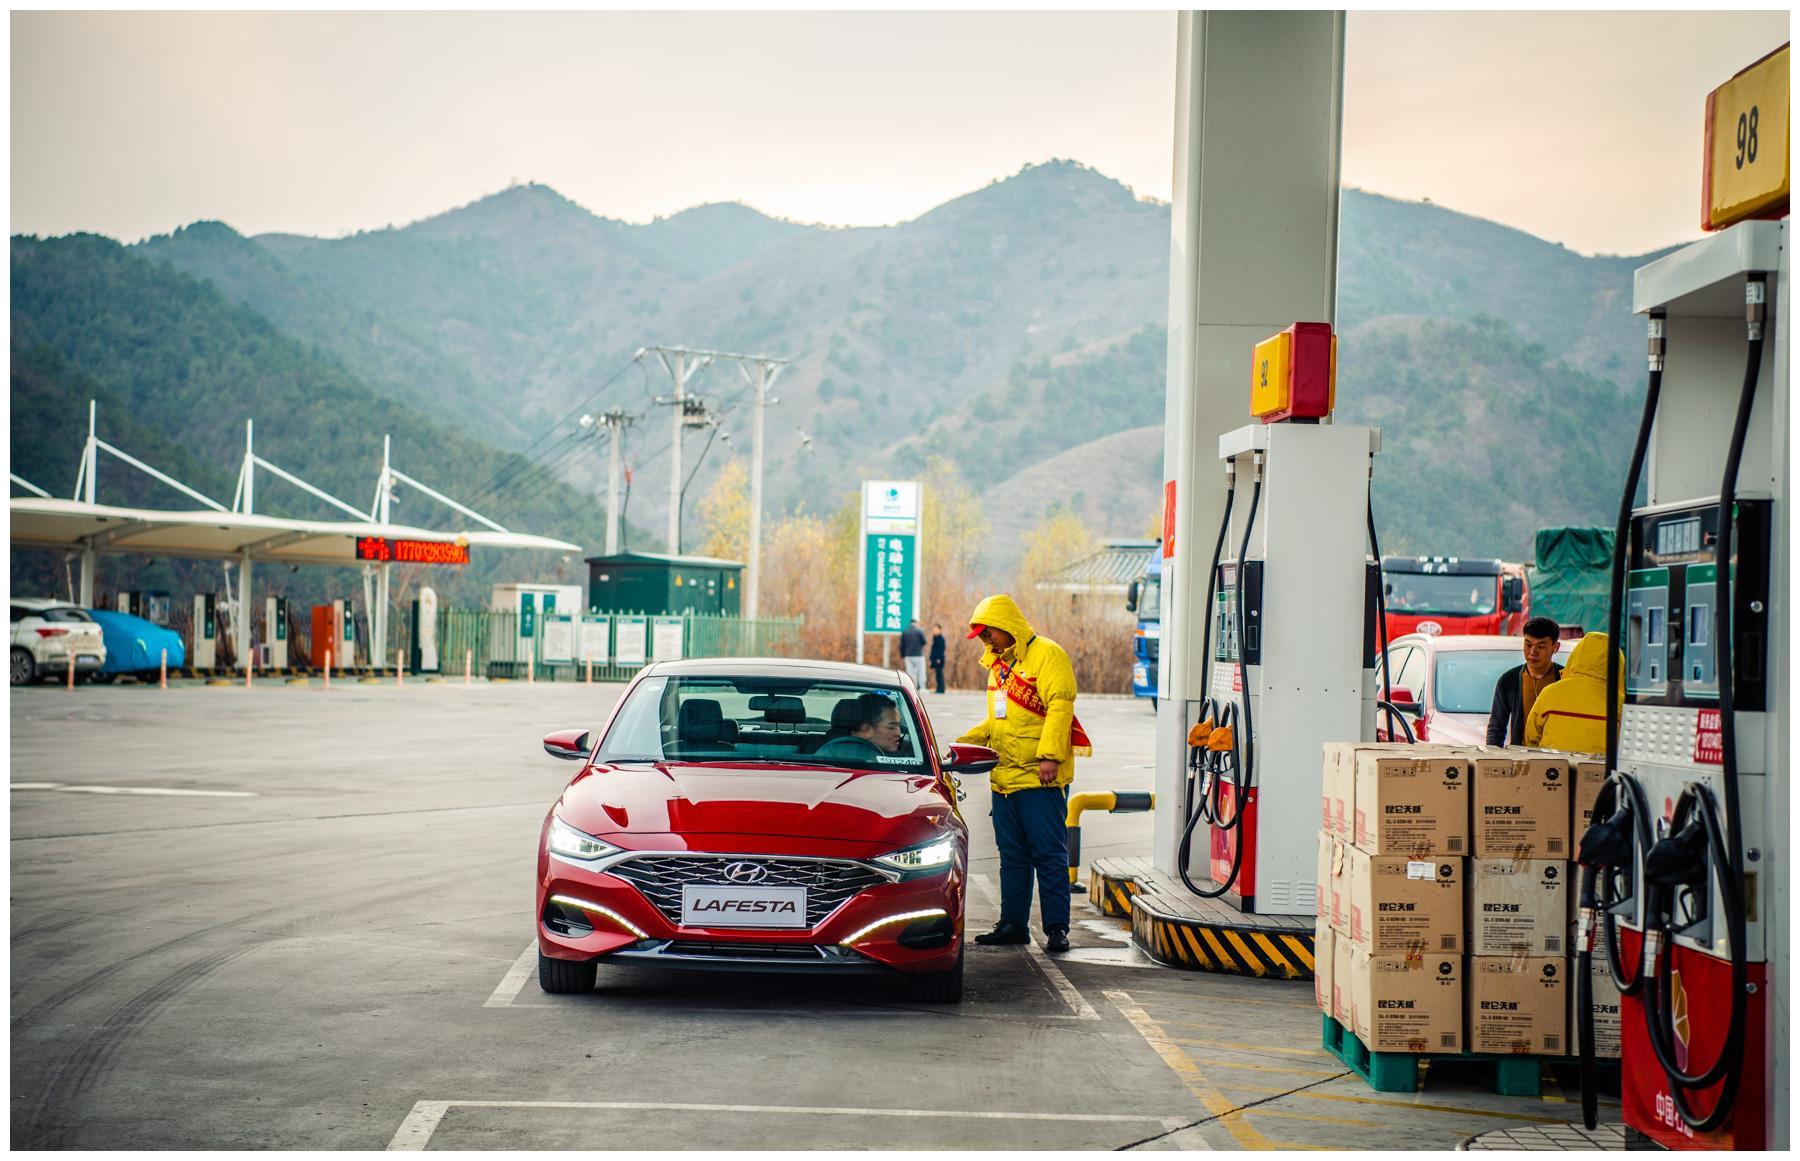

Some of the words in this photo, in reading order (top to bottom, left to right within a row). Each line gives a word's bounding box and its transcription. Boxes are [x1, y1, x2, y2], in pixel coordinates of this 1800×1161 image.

[1736, 105, 1759, 170] 98
[1261, 359, 1269, 389] 92
[887, 537, 904, 630] 电动汽车充电站
[1385, 805, 1421, 814] 昆仑天威
[1484, 806, 1521, 815] 昆仑天威
[692, 898, 796, 913] LAFESTA
[1378, 903, 1415, 912] 昆仑天威
[1483, 903, 1519, 913] 昆仑天威
[1378, 1000, 1414, 1009] 昆仑天威
[1481, 1001, 1517, 1010] 昆仑天威
